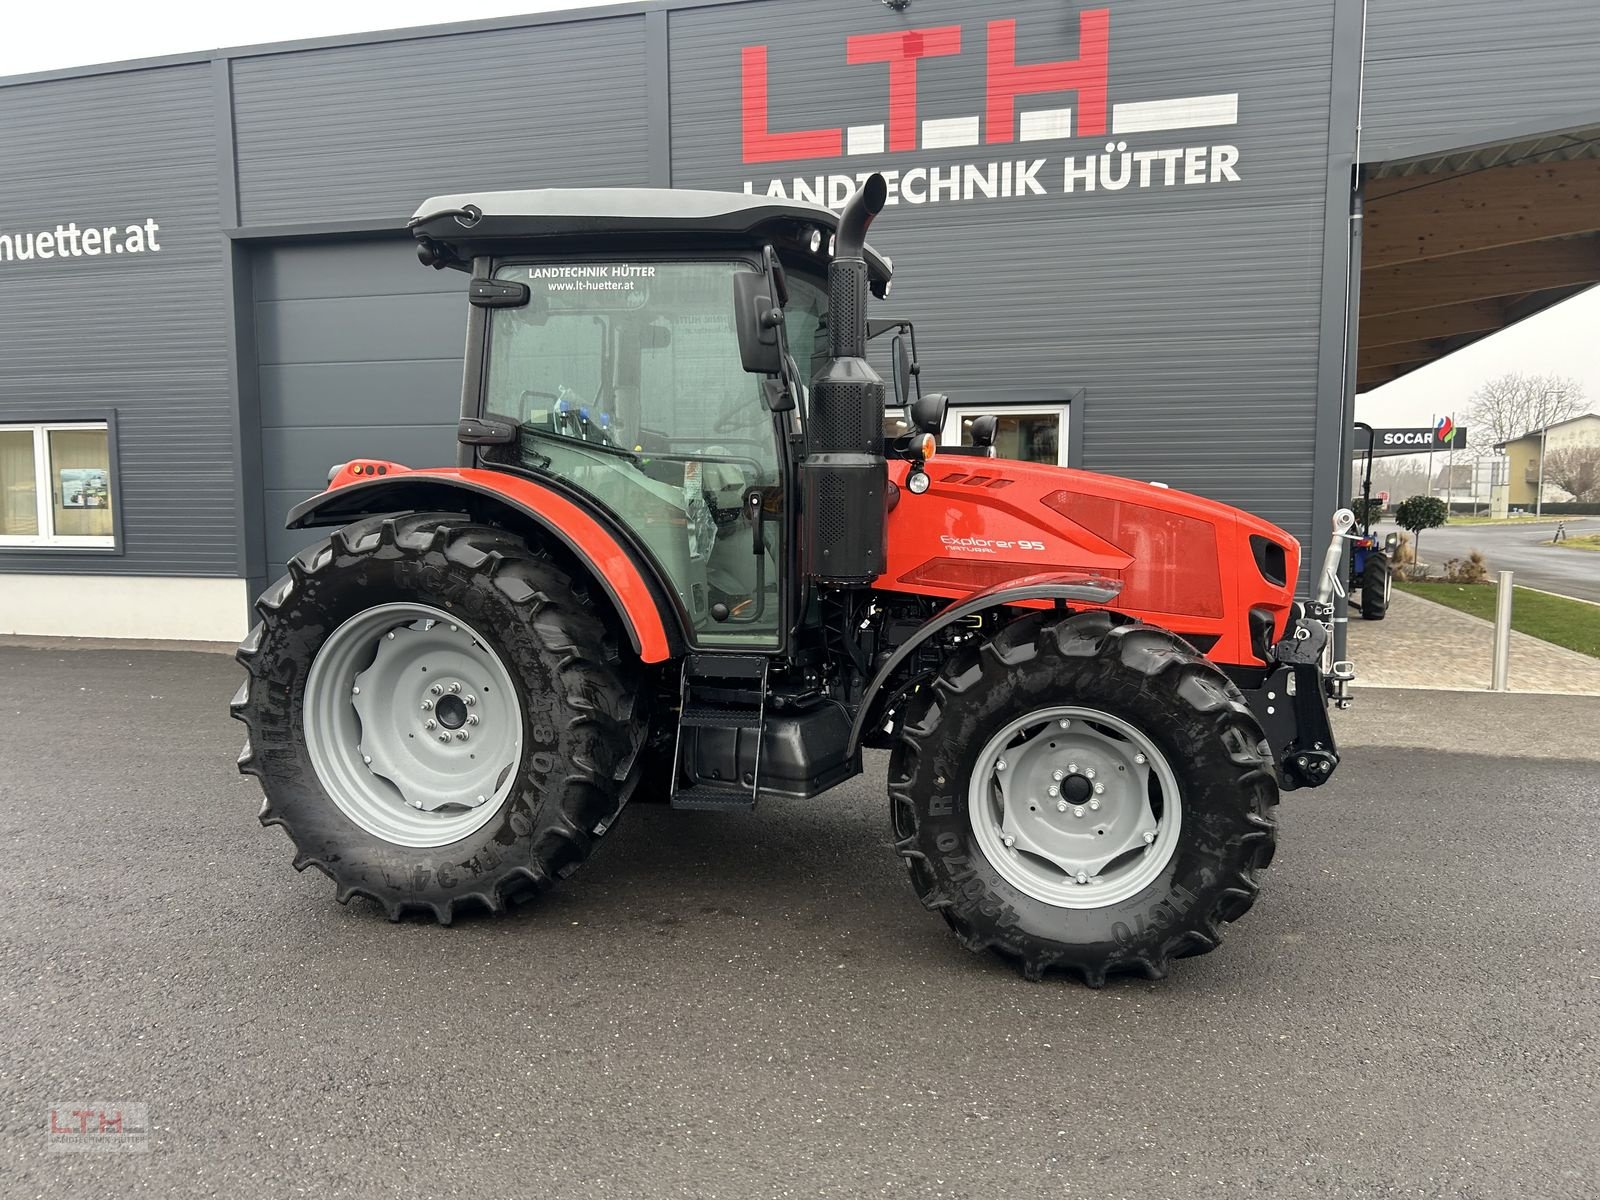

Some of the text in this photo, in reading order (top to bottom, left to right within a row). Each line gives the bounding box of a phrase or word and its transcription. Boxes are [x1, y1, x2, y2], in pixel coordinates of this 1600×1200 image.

[742, 8, 1110, 163] LTH
[1063, 141, 1242, 193] HÜTTER
[528, 264, 655, 278] LANDTECHNIK HÜTTER
[548, 280, 634, 291] www.lt-huetter.at
[1383, 432, 1433, 445] SOCAR
[940, 535, 1046, 551] Explorer 95
[945, 545, 997, 554] NATURAL
